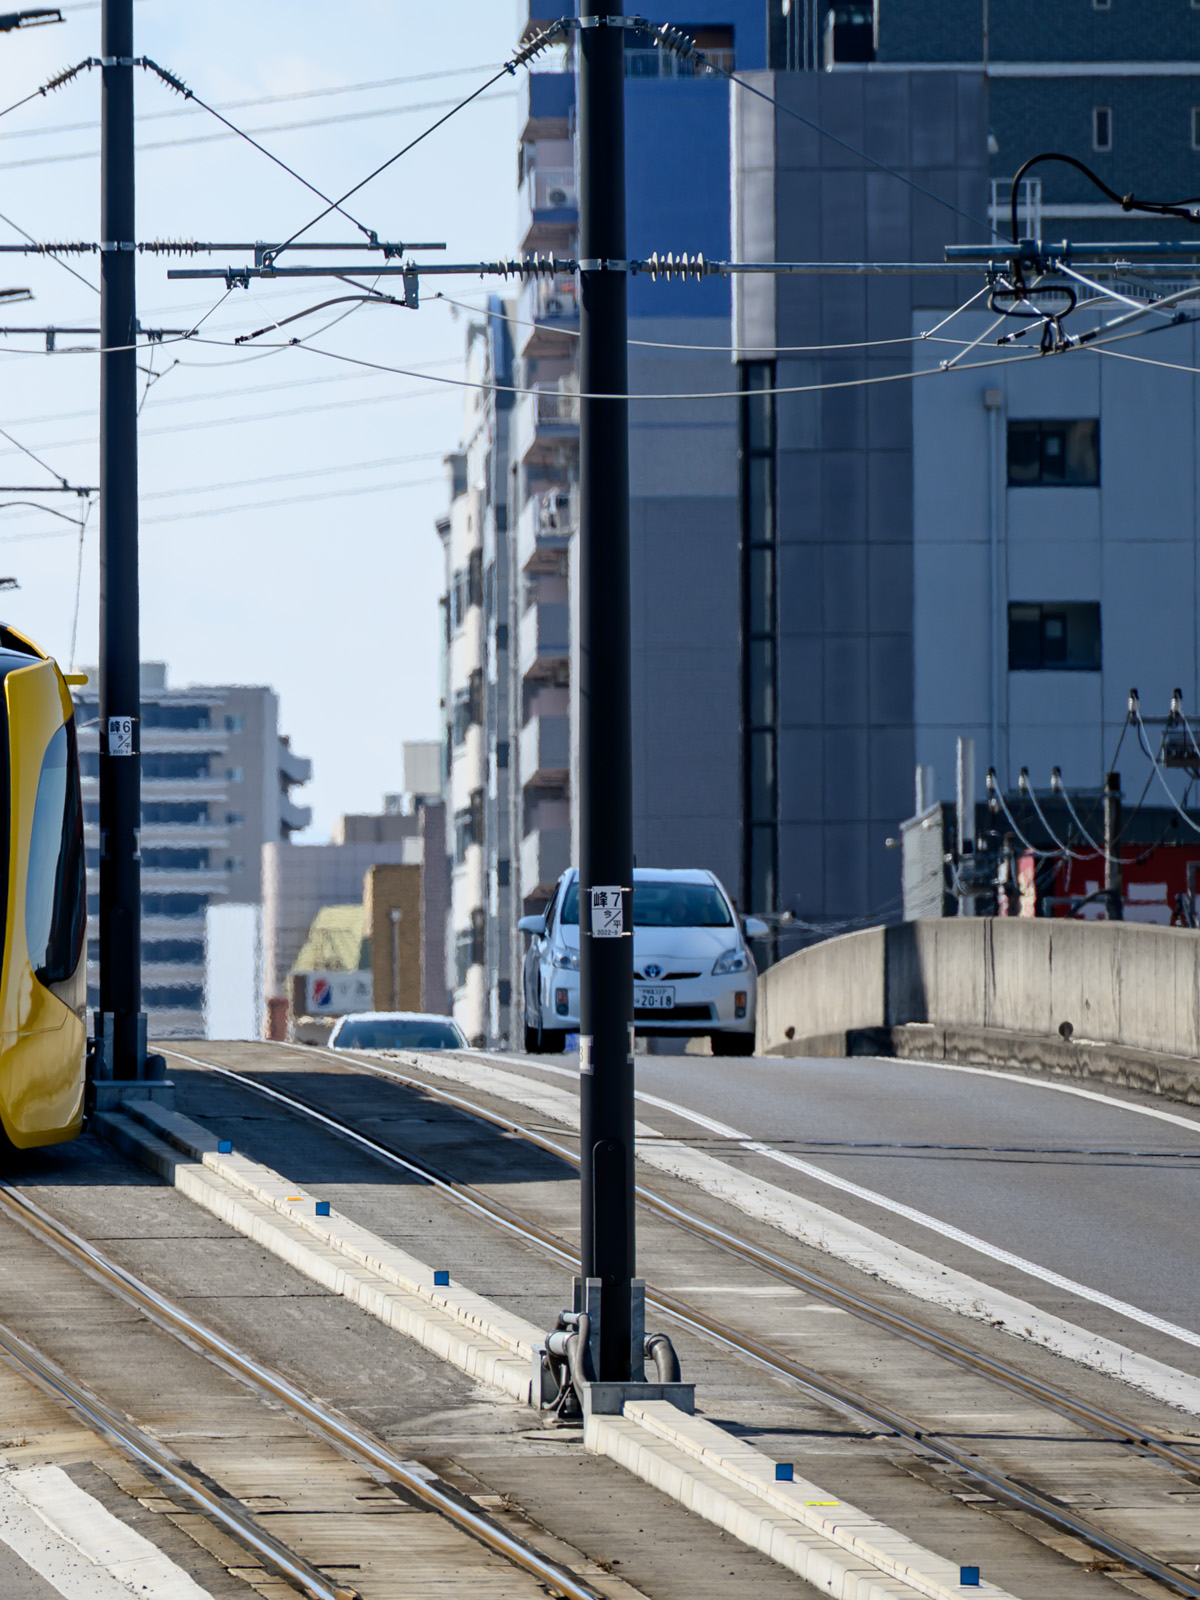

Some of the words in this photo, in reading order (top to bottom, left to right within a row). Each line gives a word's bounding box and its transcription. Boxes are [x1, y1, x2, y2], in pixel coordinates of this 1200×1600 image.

[123, 720, 130, 733] 6
[593, 891, 608, 908] 峰
[611, 892, 620, 907] 7
